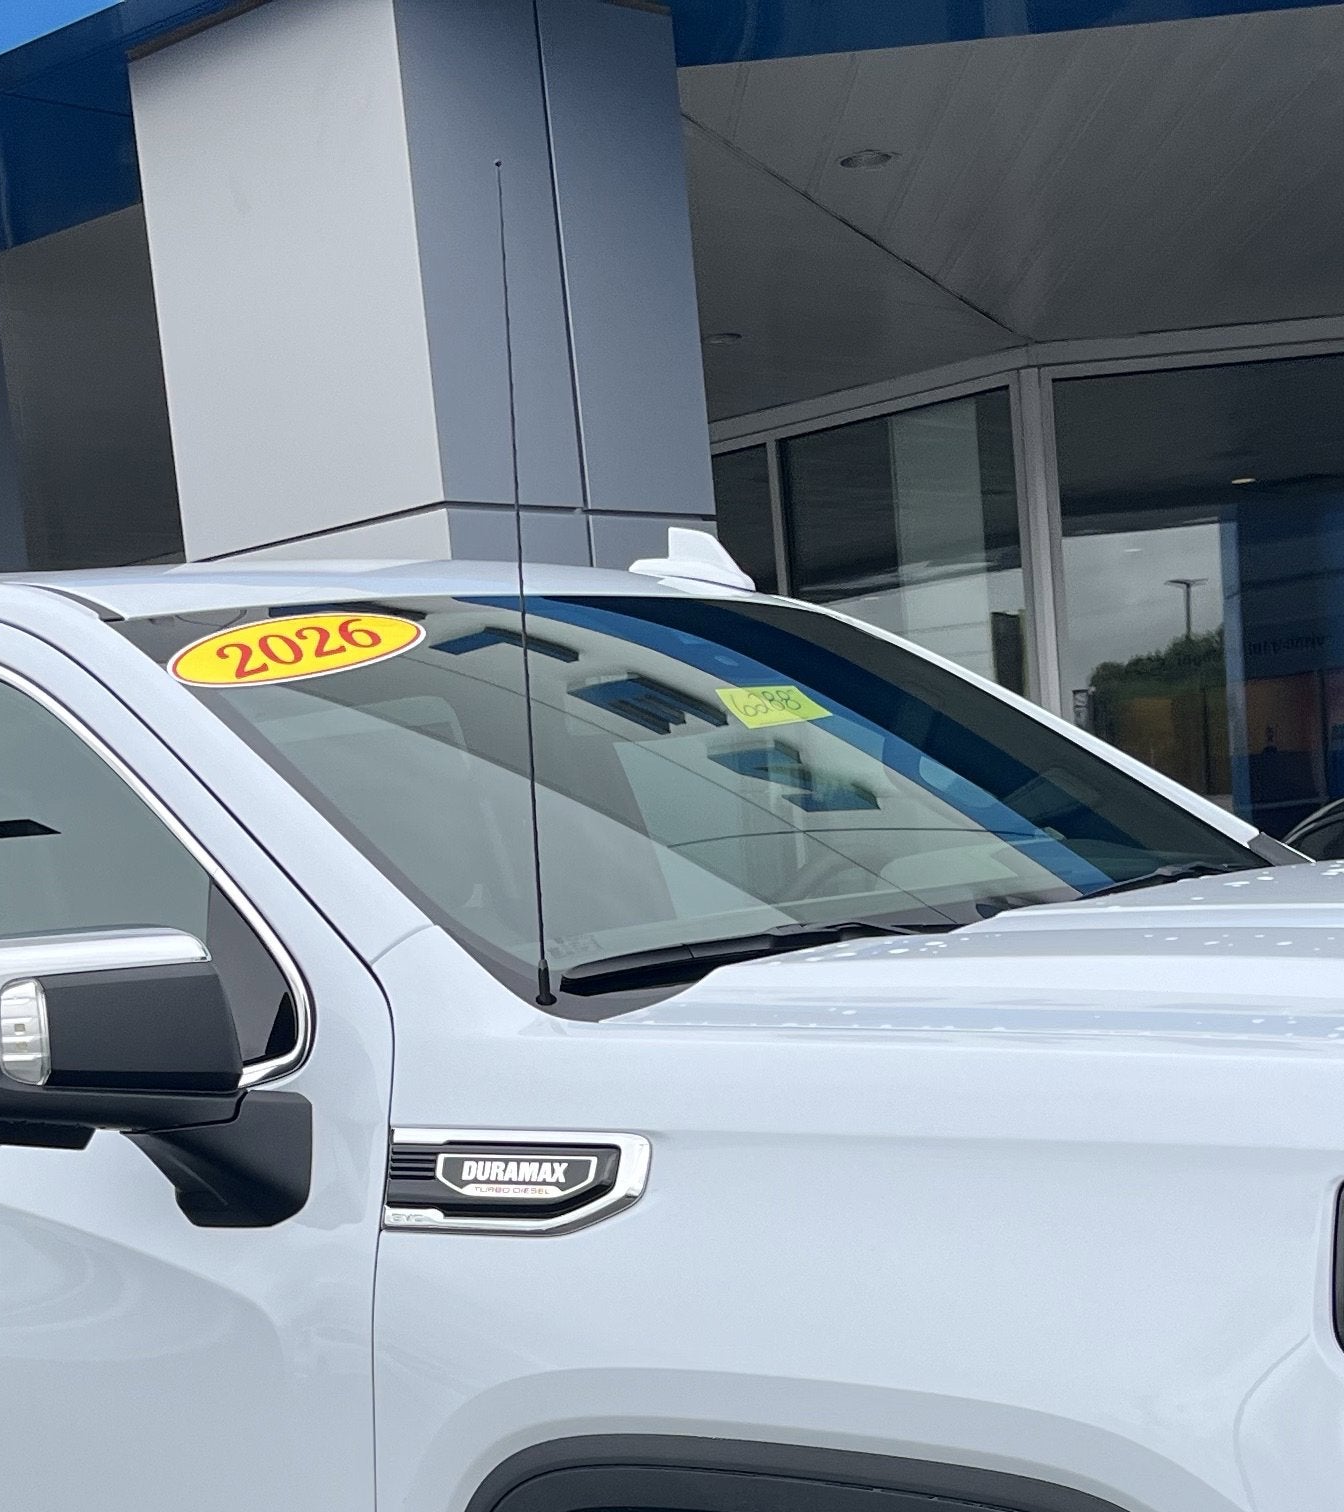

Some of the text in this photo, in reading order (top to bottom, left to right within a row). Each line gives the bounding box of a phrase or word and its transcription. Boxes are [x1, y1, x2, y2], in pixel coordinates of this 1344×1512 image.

[215, 618, 382, 680] 2026
[461, 1160, 569, 1183] DURAMAX
[474, 1186, 551, 1195] TURBO DIESEL
